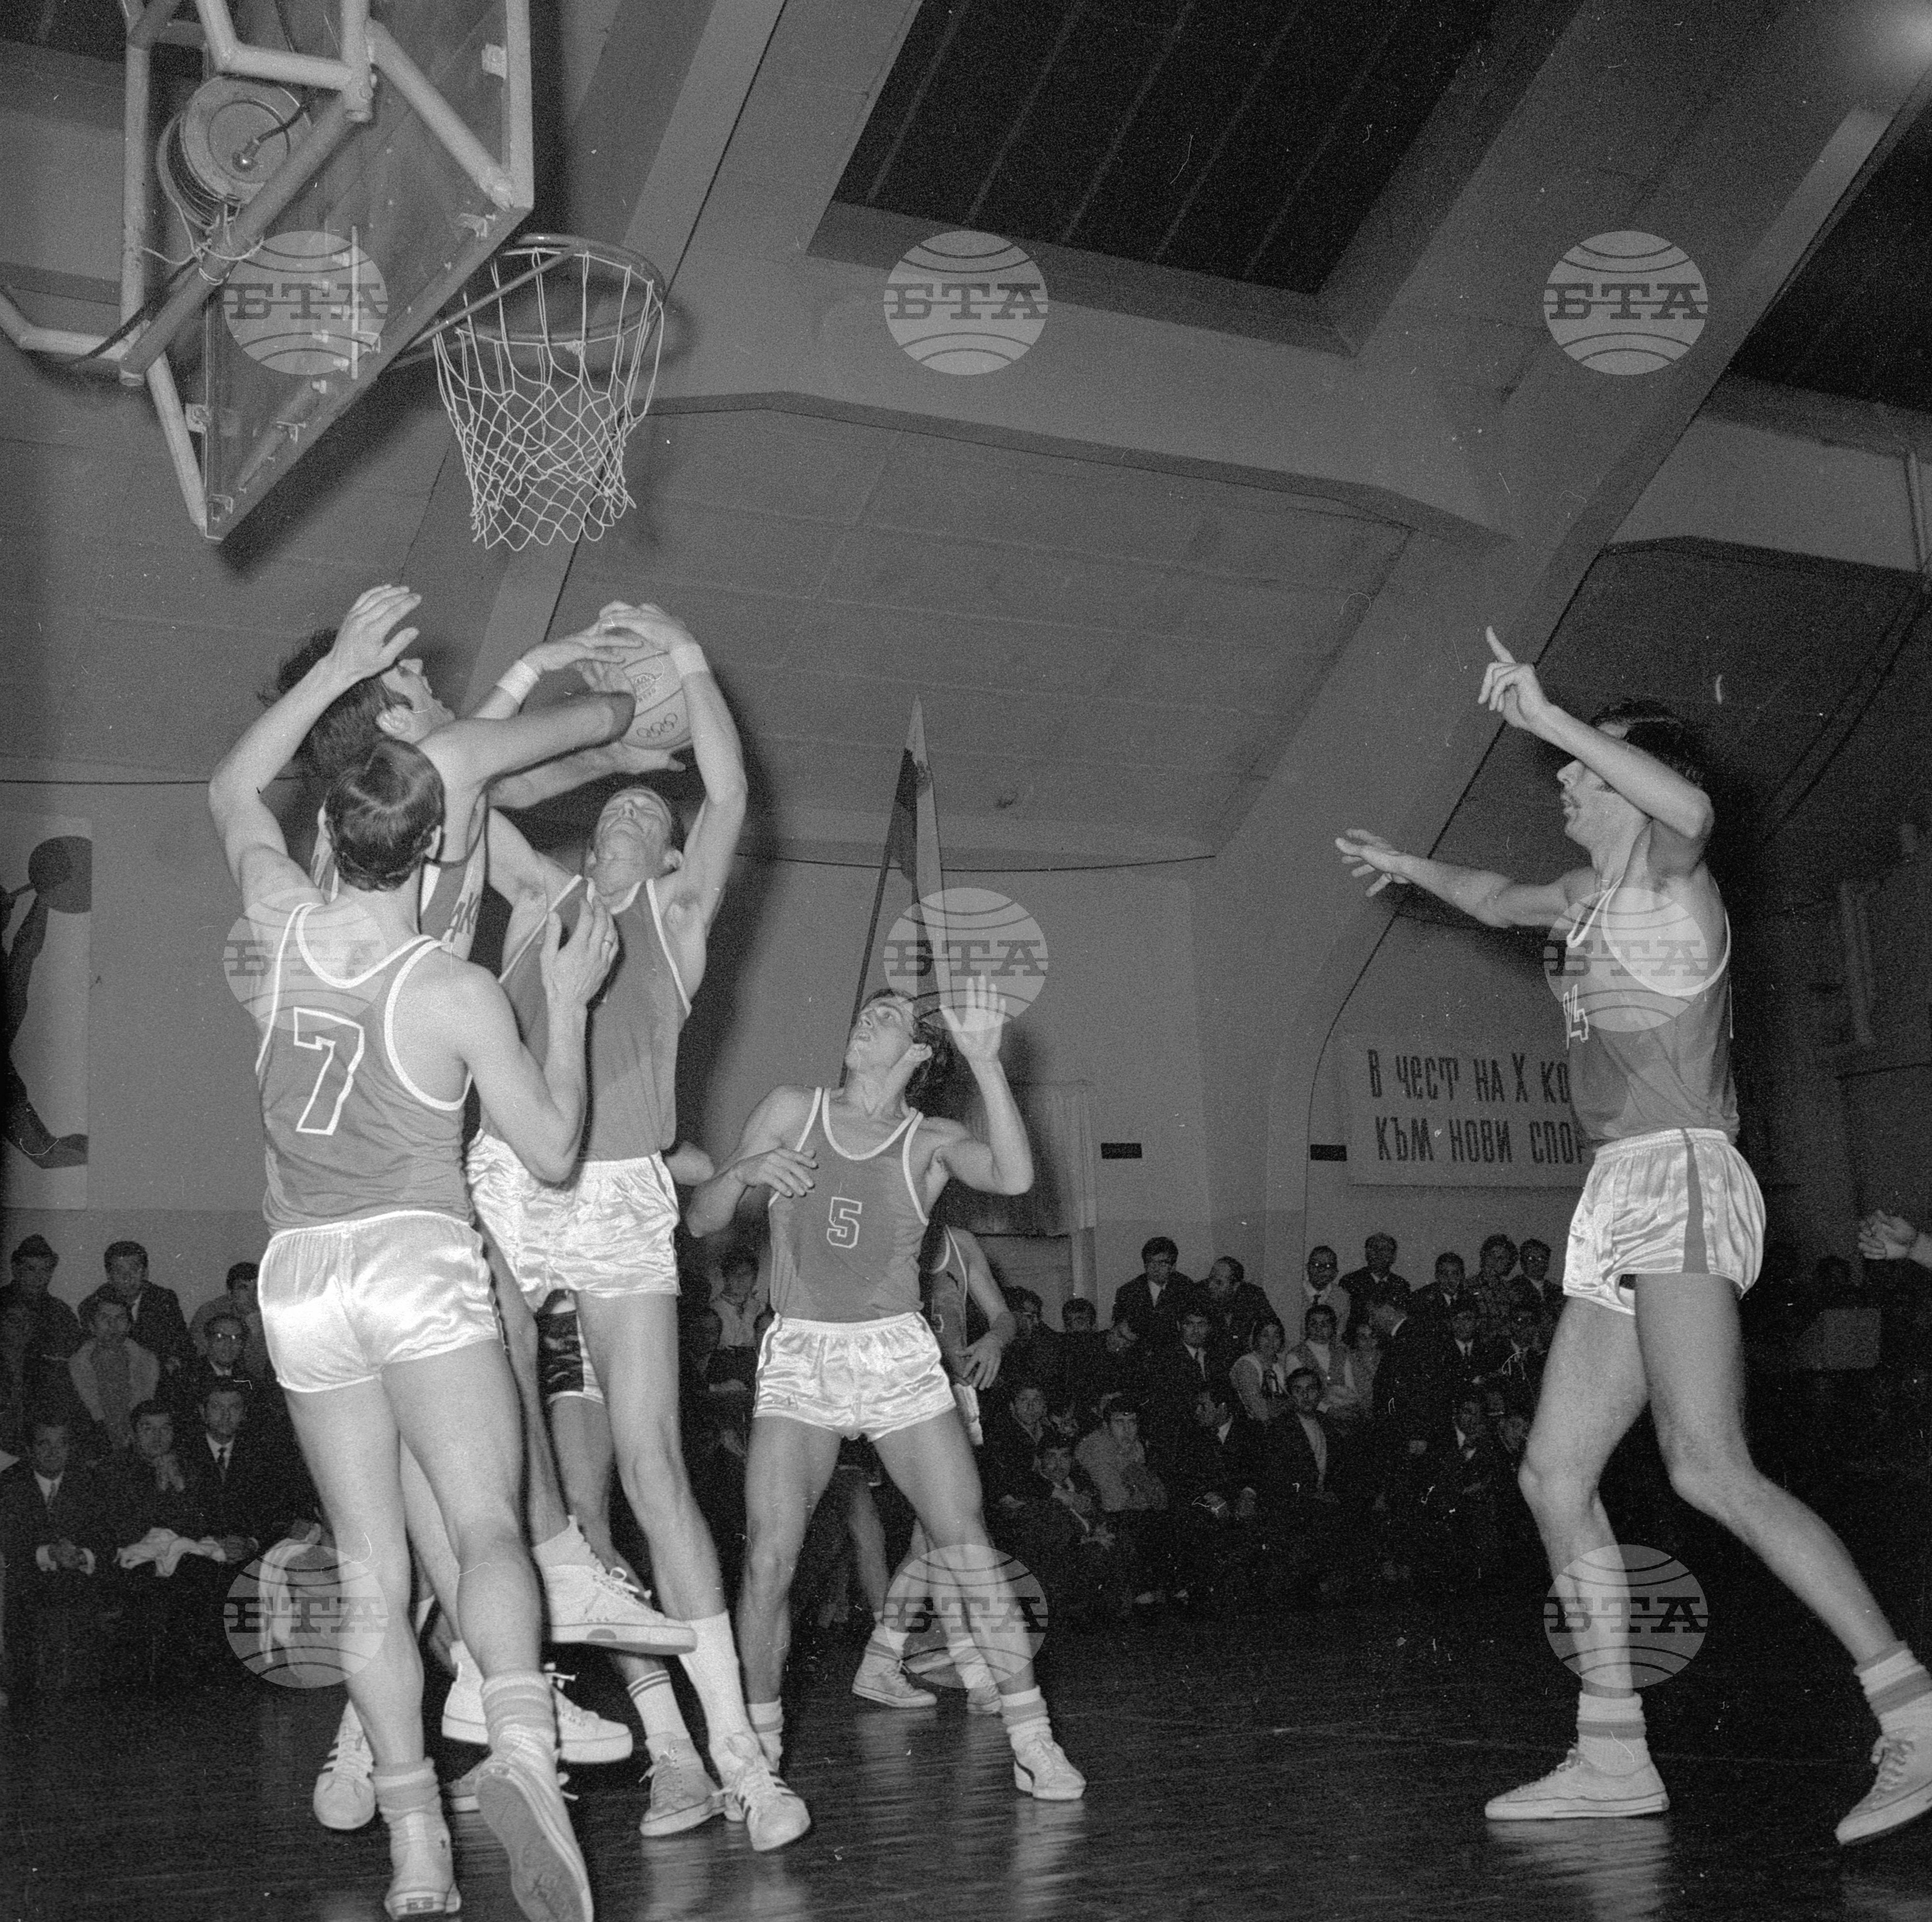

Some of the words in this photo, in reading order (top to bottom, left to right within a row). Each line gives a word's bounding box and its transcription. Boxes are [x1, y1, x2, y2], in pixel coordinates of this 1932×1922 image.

[293, 1006, 365, 1135] 7
[1367, 1049, 1382, 1098] В
[1395, 1055, 1459, 1101] ЧЕСТ
[1473, 1059, 1505, 1102] НА
[1375, 1116, 1434, 1160] КЪМ
[1449, 1118, 1512, 1162] НОВИ
[826, 1196, 862, 1249] 5
